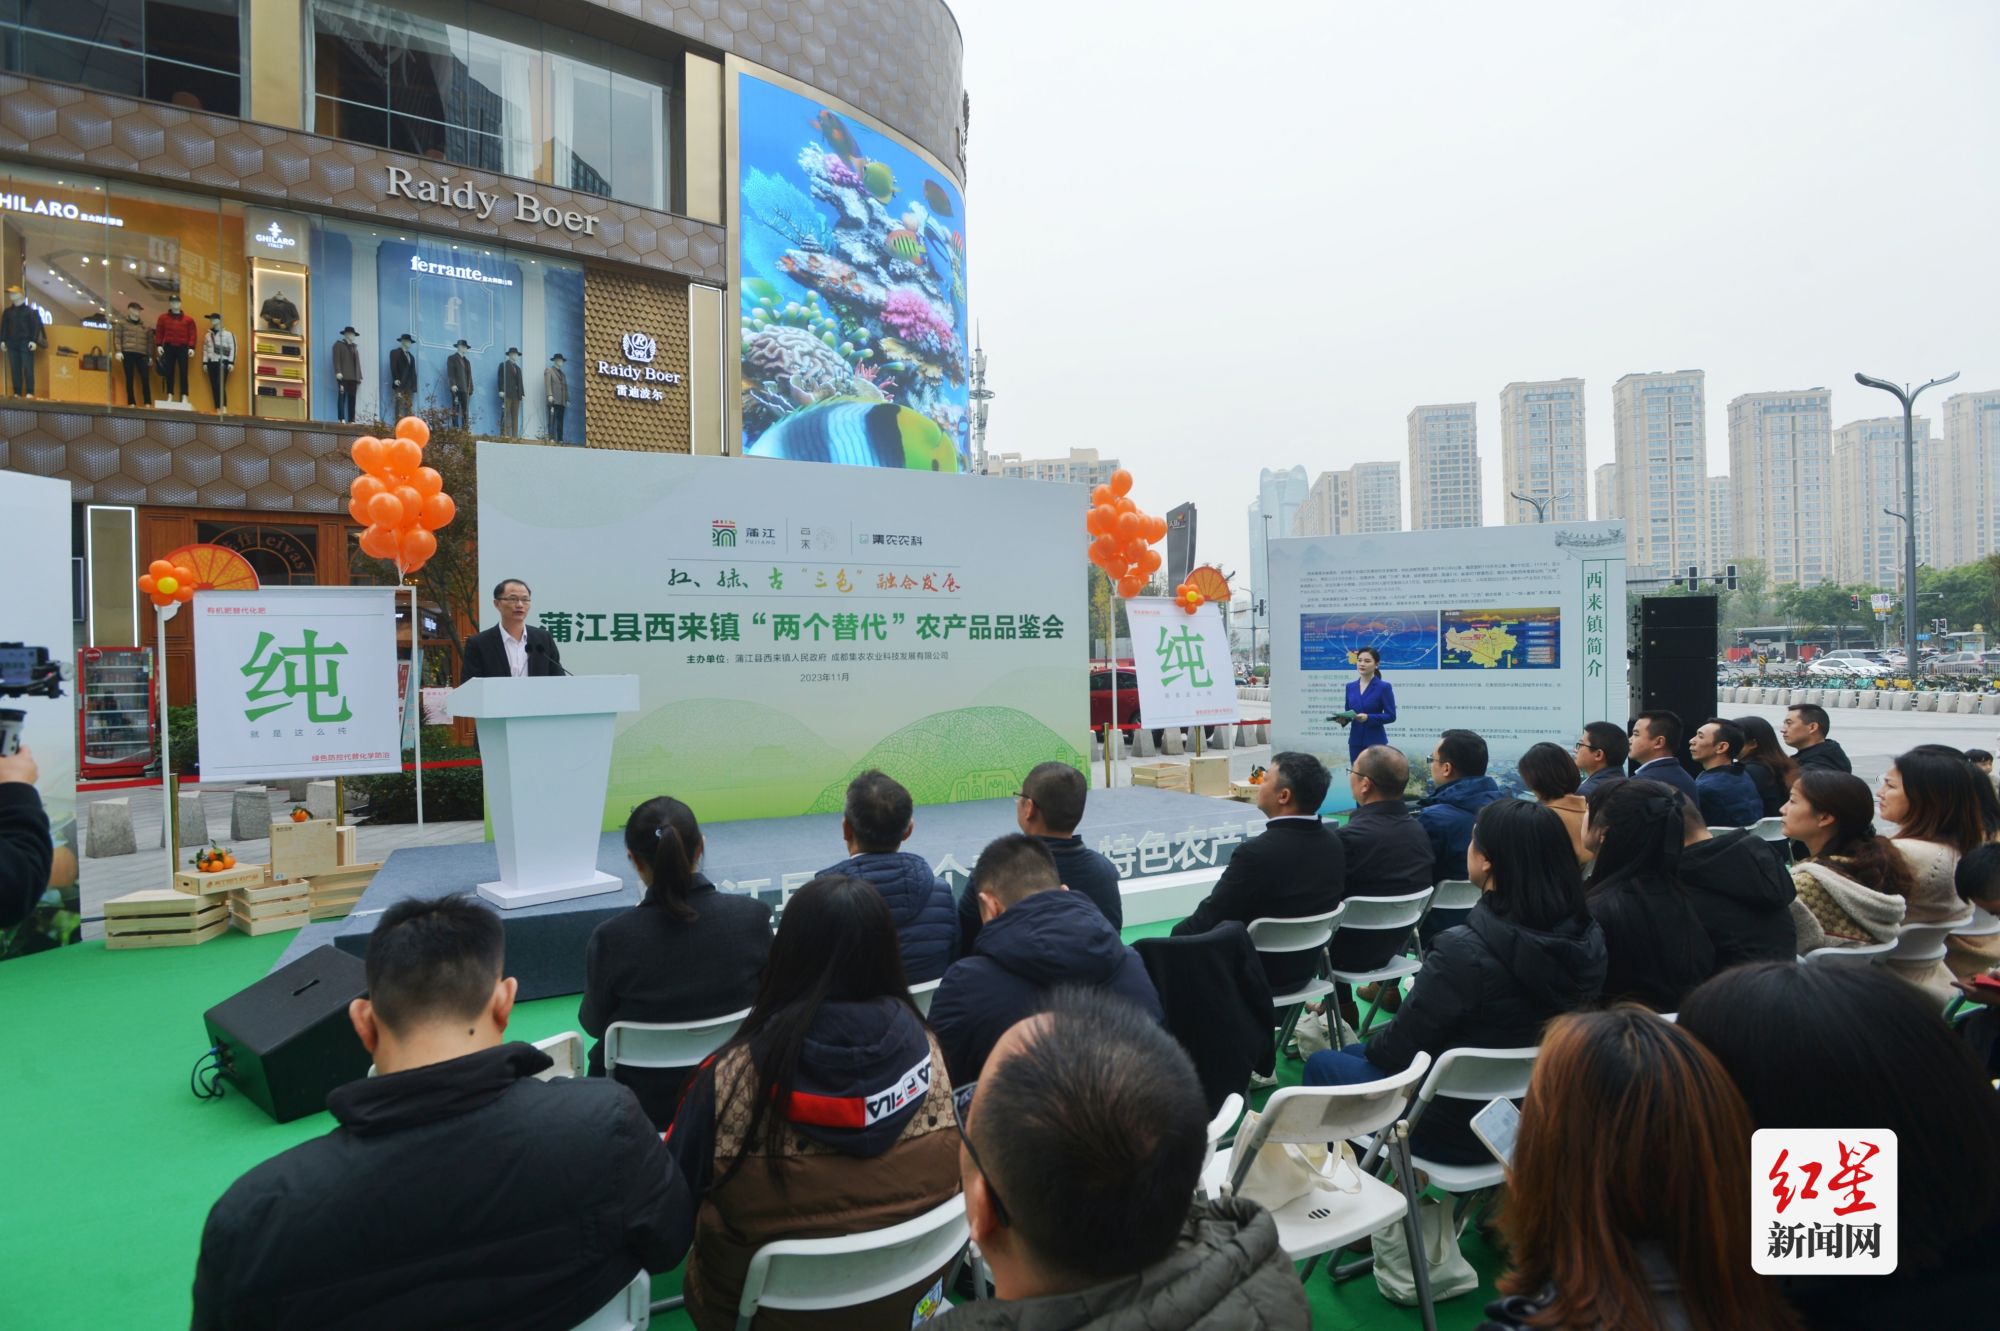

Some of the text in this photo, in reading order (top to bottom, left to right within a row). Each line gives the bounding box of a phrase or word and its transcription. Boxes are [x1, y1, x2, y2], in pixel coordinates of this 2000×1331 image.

[385, 165, 600, 236] Raidy Boer
[255, 234, 296, 247] GHILARO
[410, 255, 482, 281] ferrante
[598, 361, 681, 384] Raidy Boer
[616, 384, 663, 401] 雷迪波尔
[746, 527, 776, 538] 蒲江
[1586, 571, 1603, 678] 西来镇简介
[1156, 624, 1213, 688] 纯
[240, 629, 352, 723] 纯
[800, 672, 850, 682] 2023年11月
